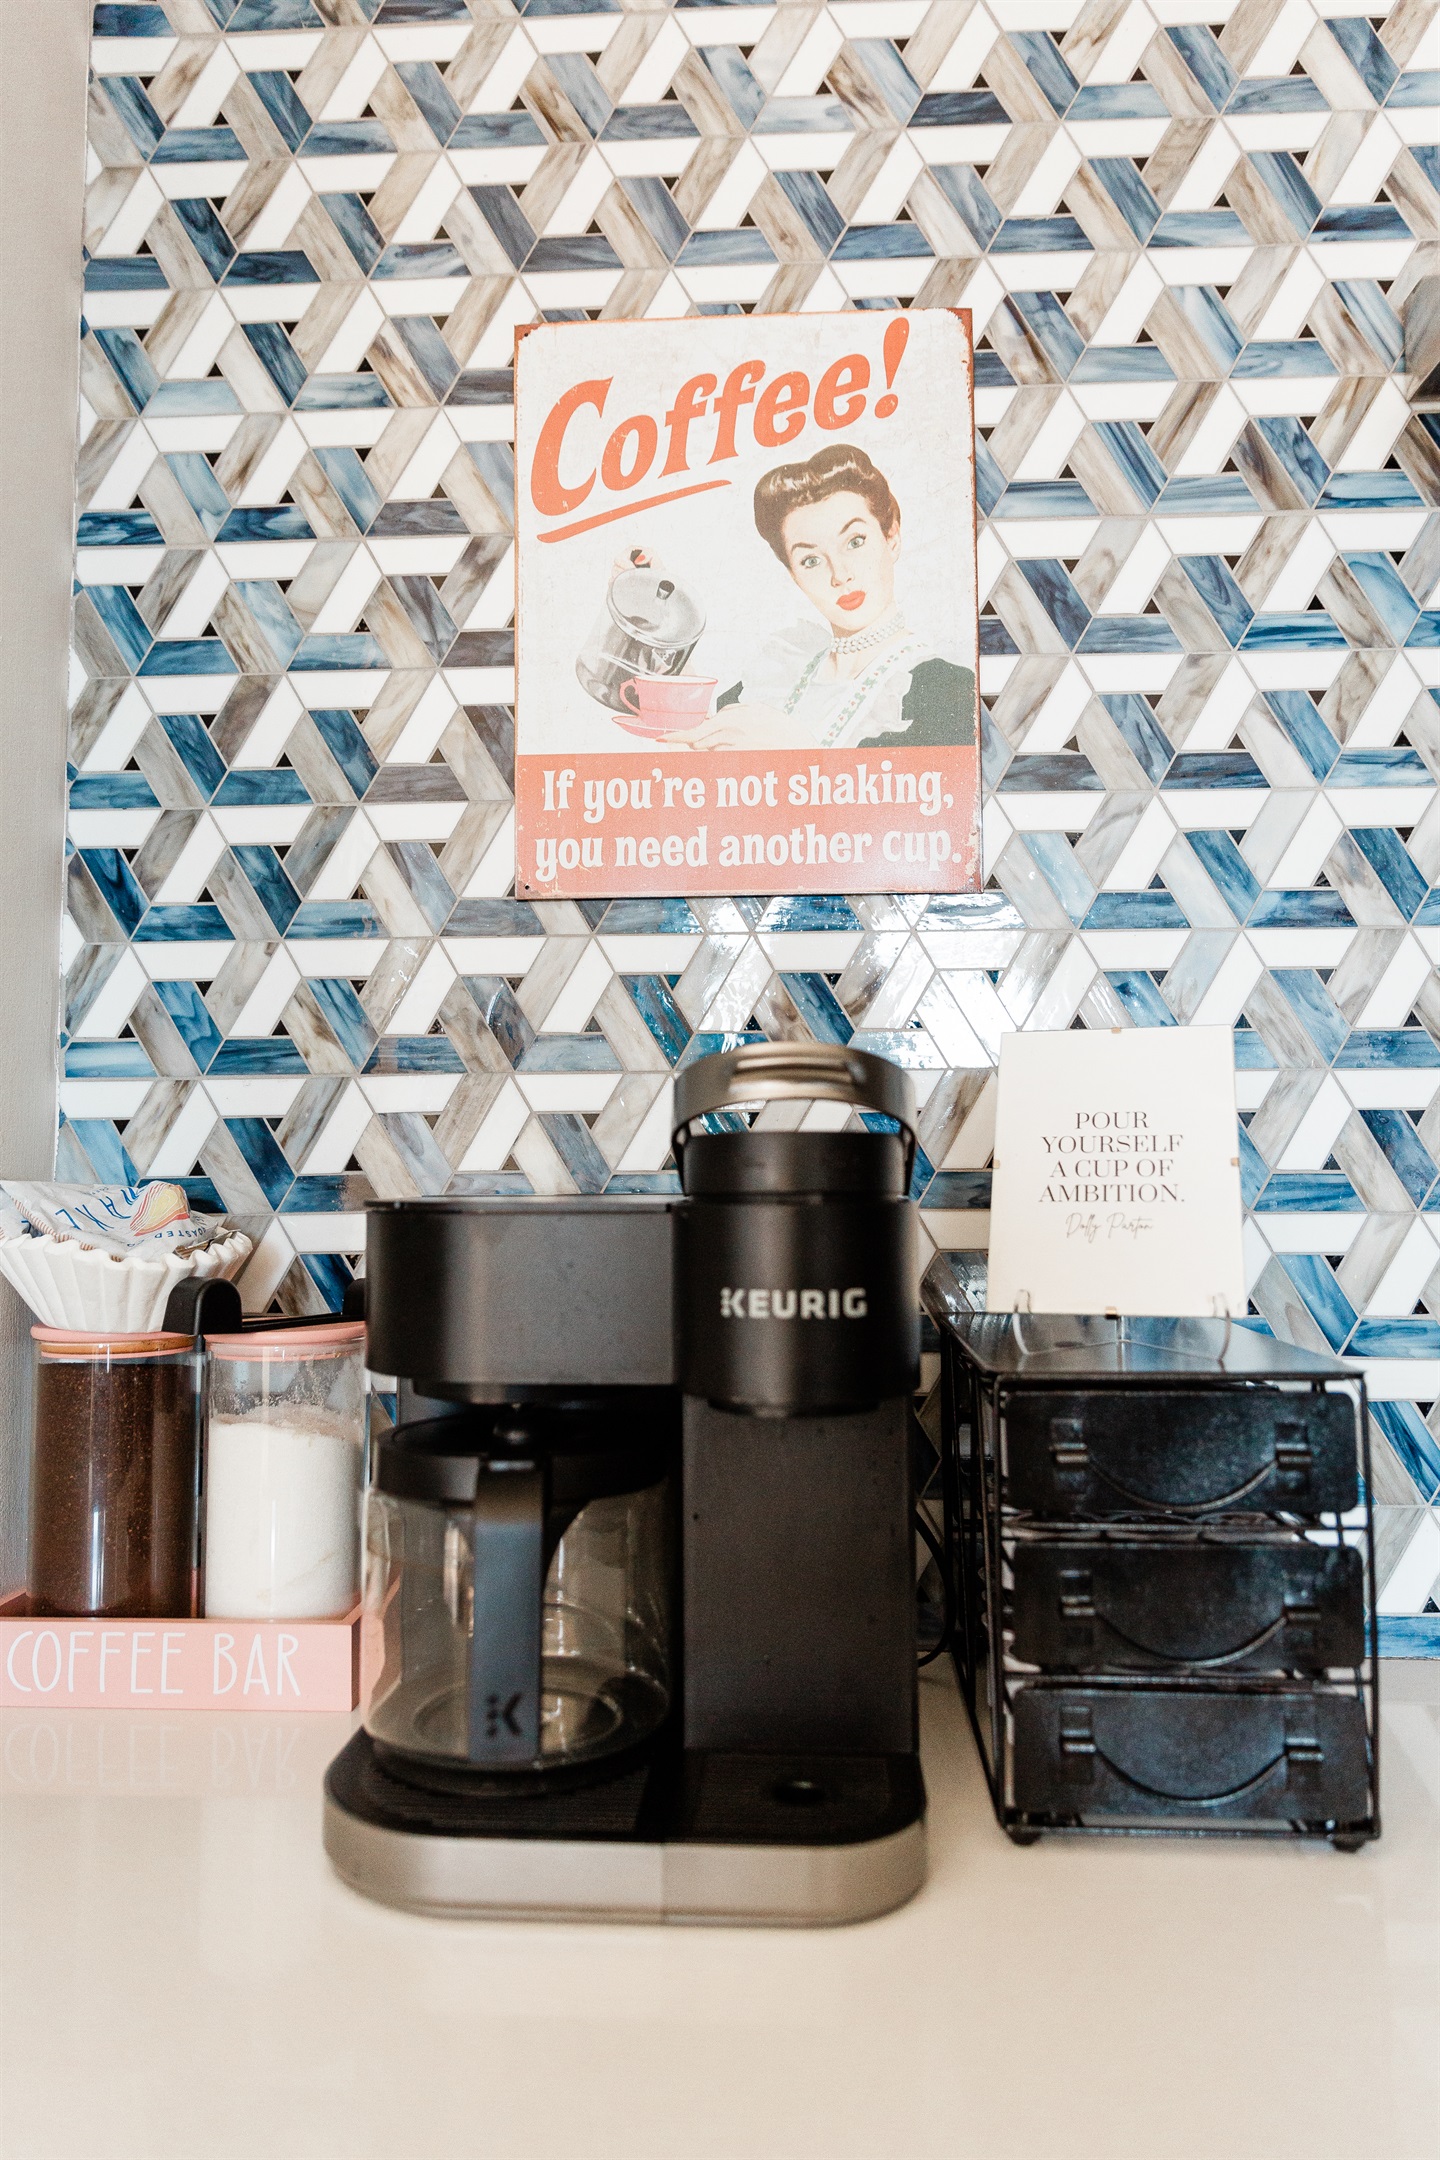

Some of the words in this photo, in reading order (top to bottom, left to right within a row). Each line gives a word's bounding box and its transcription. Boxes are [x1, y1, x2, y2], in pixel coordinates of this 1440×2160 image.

[531, 316, 910, 516] Coffee!
[542, 768, 576, 811] If
[583, 768, 705, 823] you're
[716, 770, 778, 809] not
[787, 760, 954, 816] shaking,
[535, 836, 602, 881] you
[614, 827, 707, 867] need
[720, 824, 872, 866] another
[882, 829, 962, 871] cup.
[1075, 1111, 1149, 1129] POUR
[1041, 1134, 1184, 1154] YOURSELF
[1049, 1160, 1068, 1178] A
[1075, 1159, 1129, 1178] CUP
[1136, 1158, 1175, 1177] OF
[1038, 1183, 1185, 1203] AMBITION.
[1065, 1212, 1101, 1244] Dolly
[1106, 1212, 1153, 1240] Parton
[720, 1286, 868, 1320] KEURIG
[6, 1630, 186, 1695] COFFEE
[213, 1632, 301, 1697] BAR
[486, 1693, 522, 1738] K
